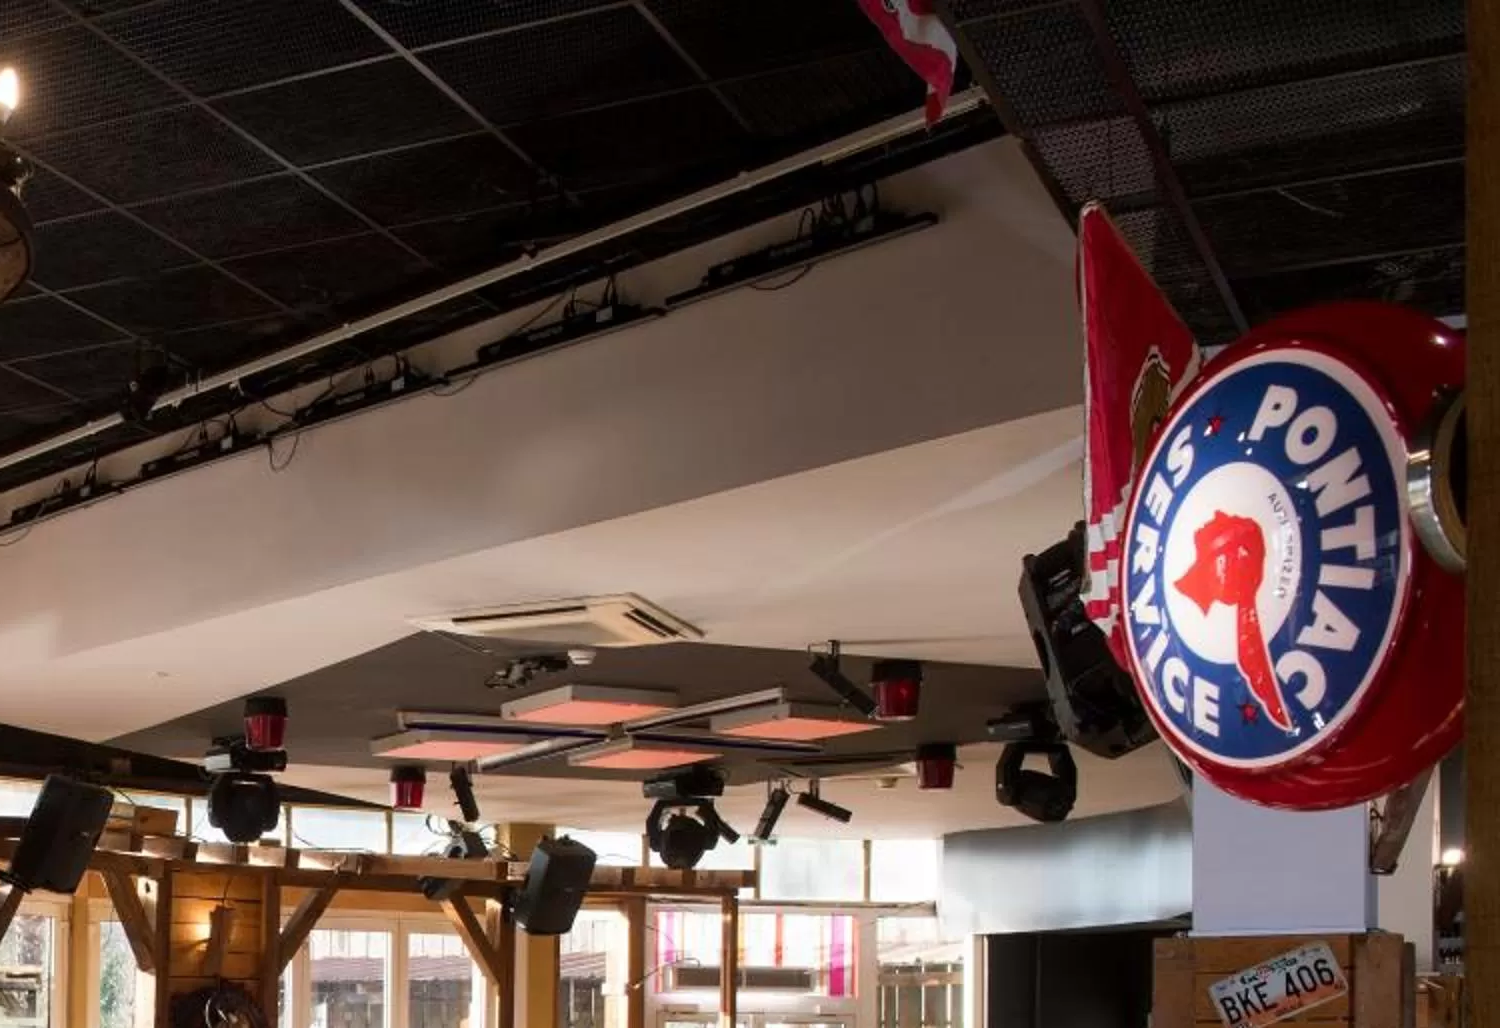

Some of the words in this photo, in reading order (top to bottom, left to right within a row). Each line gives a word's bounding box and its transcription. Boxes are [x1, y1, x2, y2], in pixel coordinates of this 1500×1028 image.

[1132, 424, 1221, 737] SERVICE
[1247, 384, 1377, 711] PONTIAC
[1220, 981, 1278, 1024] BKE
[1285, 958, 1335, 998] 406
